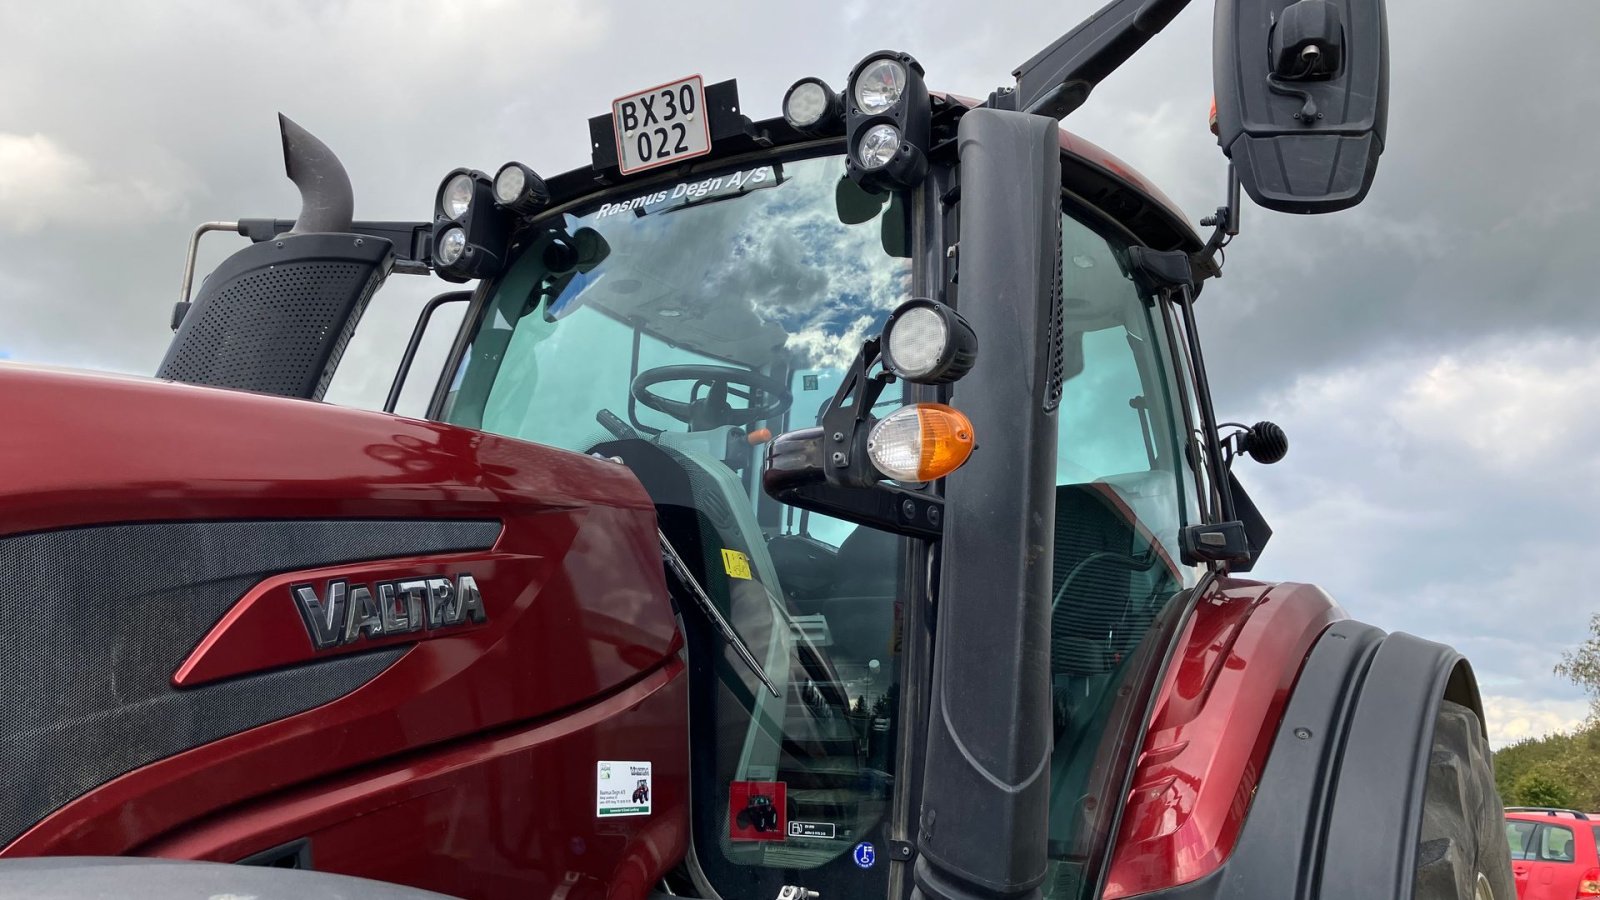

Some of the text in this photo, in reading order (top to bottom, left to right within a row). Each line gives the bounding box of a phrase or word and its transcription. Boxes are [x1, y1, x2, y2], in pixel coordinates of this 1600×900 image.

[622, 84, 695, 132] BX30
[637, 122, 689, 162] 022
[596, 166, 768, 219] Rasmus Degn A/S
[292, 574, 486, 650] VALTRA
